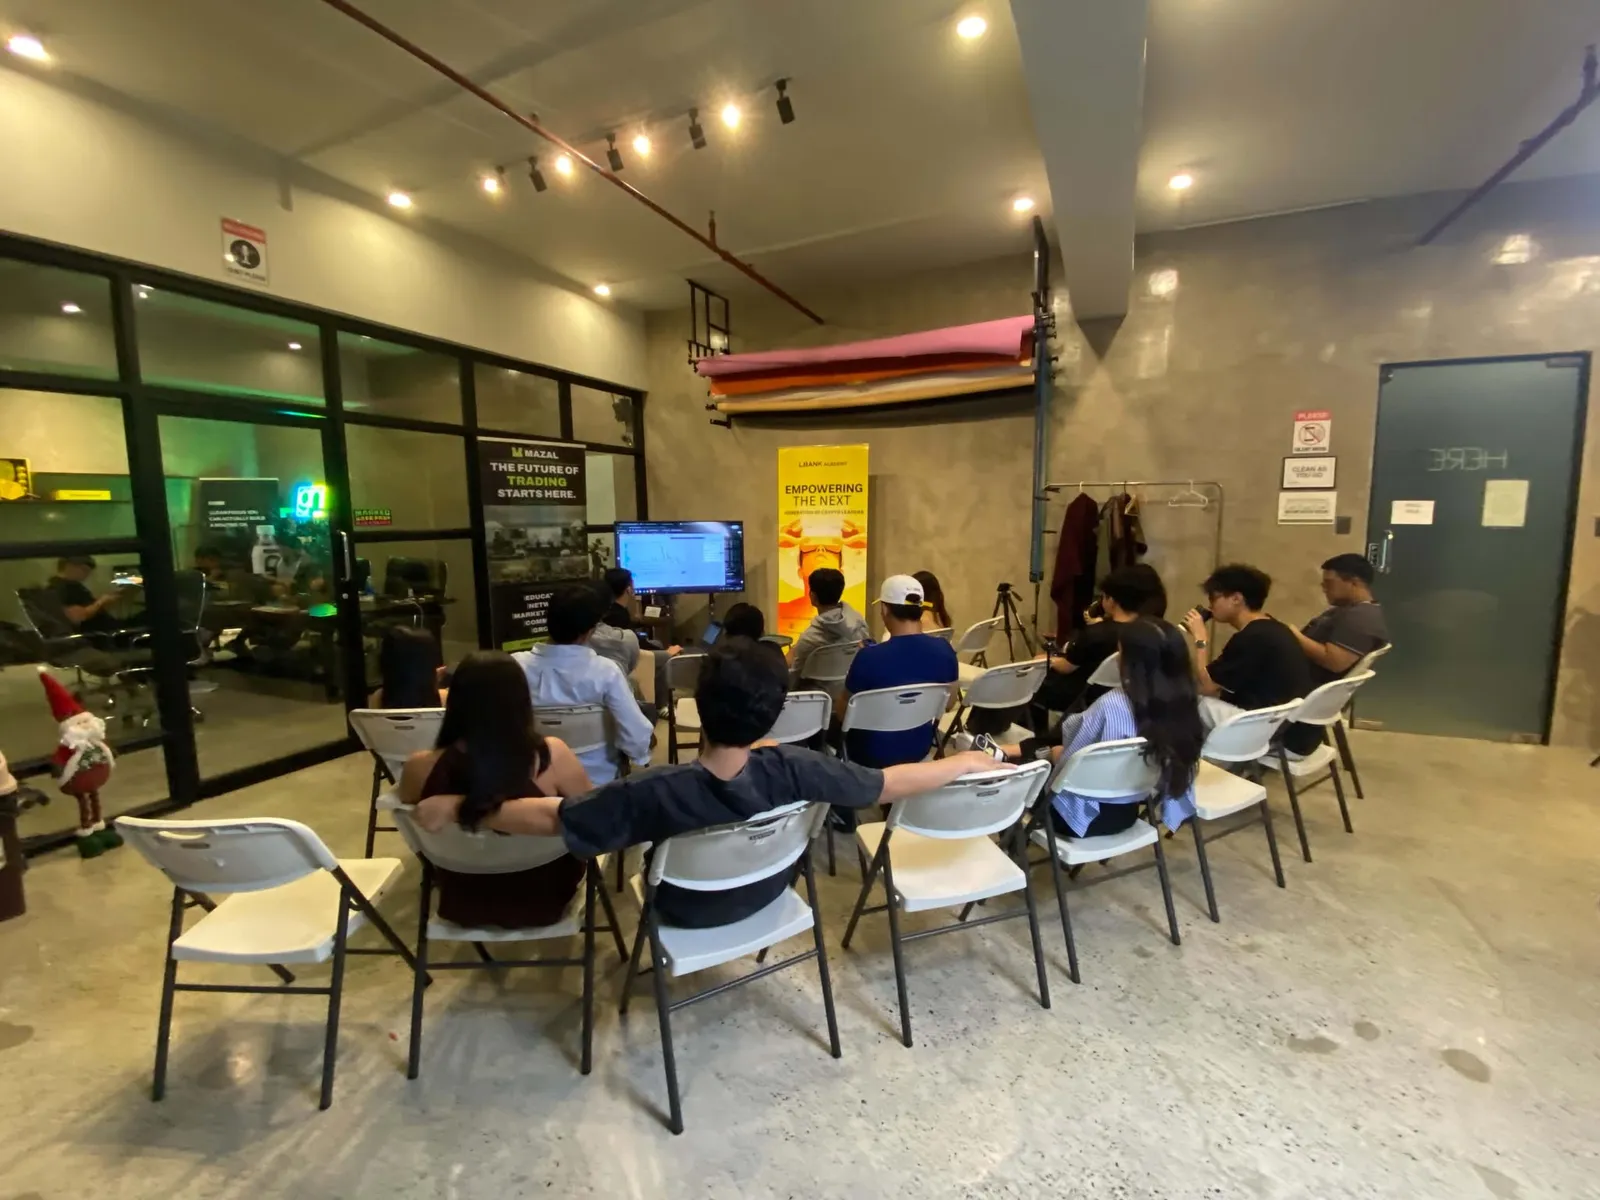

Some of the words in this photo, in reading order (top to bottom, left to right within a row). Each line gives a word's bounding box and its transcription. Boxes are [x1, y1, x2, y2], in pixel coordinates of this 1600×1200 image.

[524, 449, 559, 459] MAZAL
[490, 462, 516, 472] THE
[517, 463, 564, 474] FUTURE
[565, 466, 579, 475] OF
[507, 475, 567, 487] TRADING
[497, 488, 543, 498] STARTS
[544, 489, 576, 499] HERE.
[785, 484, 863, 495] EMPOWERING
[793, 495, 816, 507] THE
[820, 494, 851, 506] NEXT
[512, 610, 546, 619] MARKET
